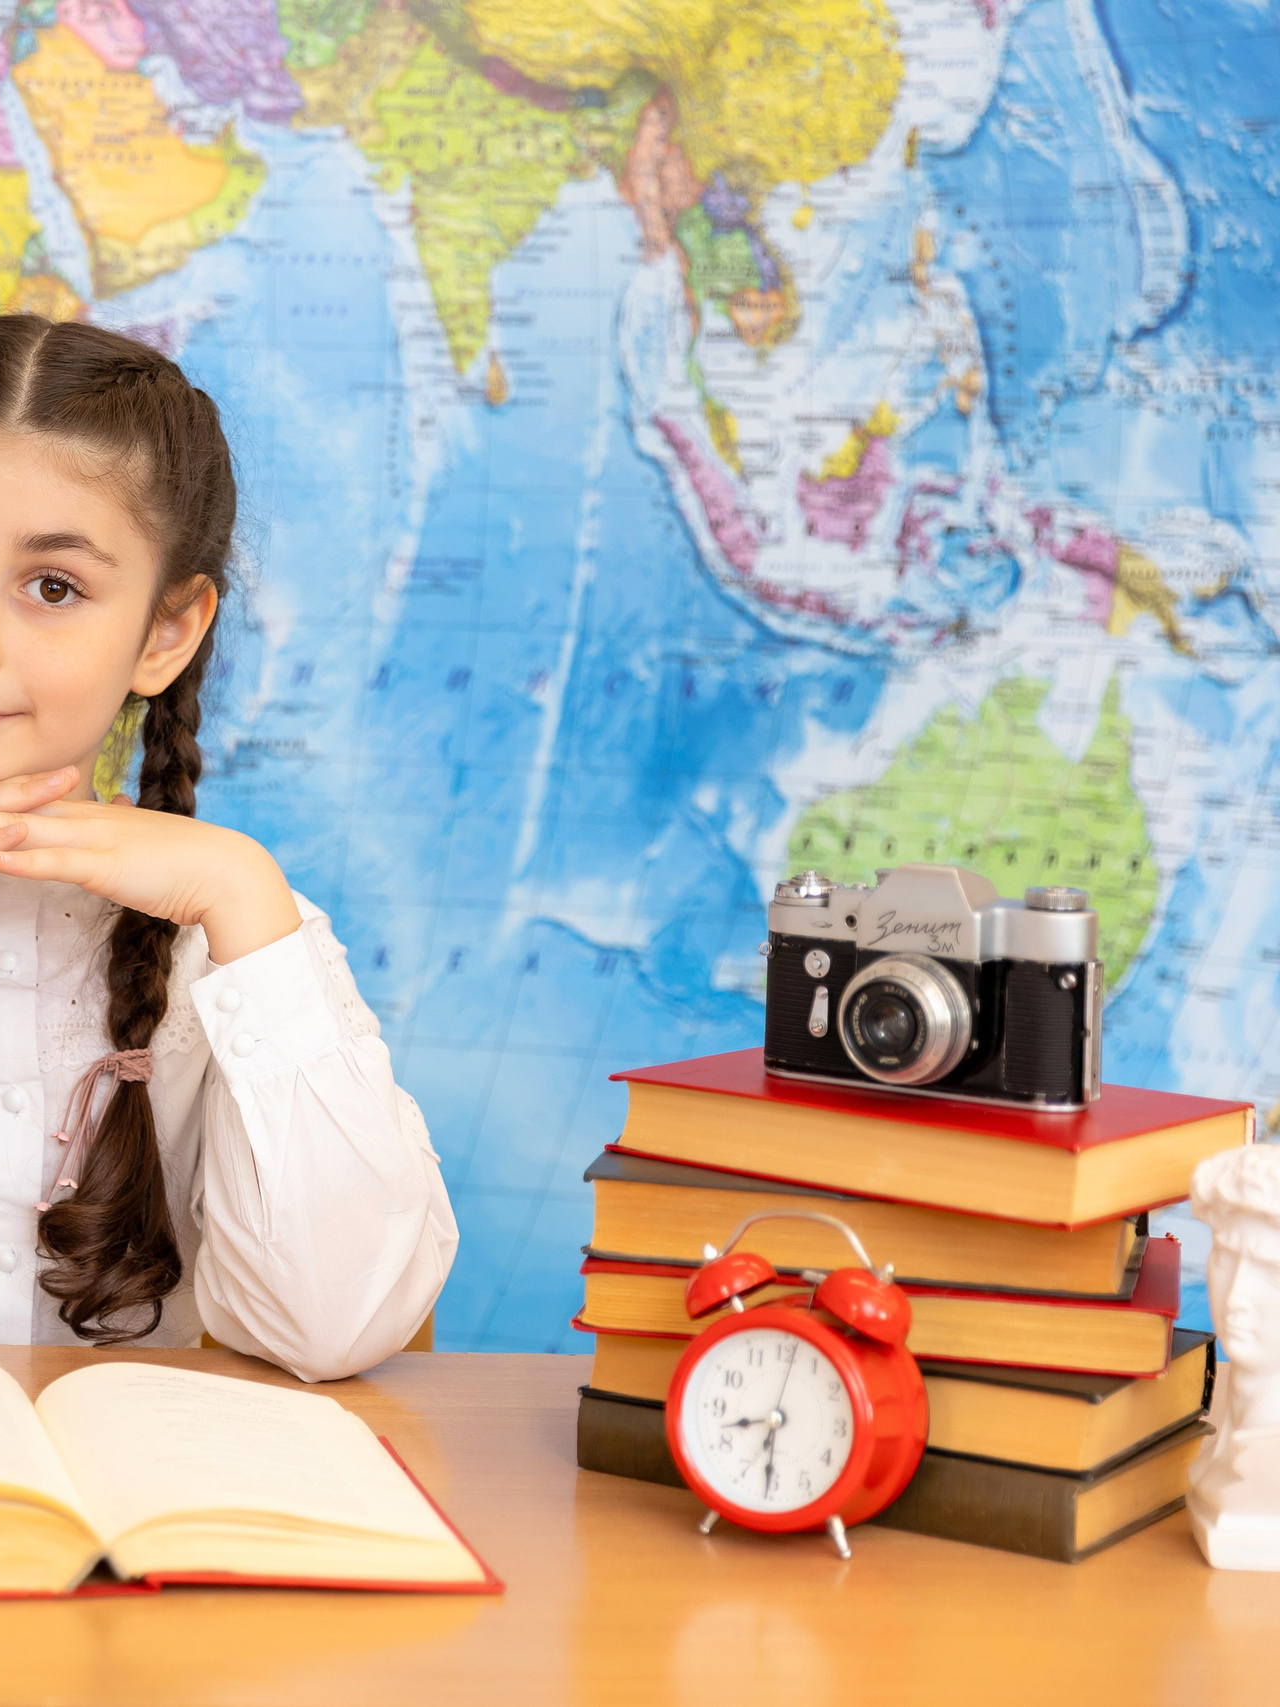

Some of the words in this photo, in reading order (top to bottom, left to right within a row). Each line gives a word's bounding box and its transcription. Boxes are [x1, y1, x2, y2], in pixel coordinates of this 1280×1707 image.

[746, 1348, 764, 1368] 11
[776, 1343, 798, 1365] 12
[811, 1357, 818, 1375] 1
[724, 1369, 744, 1390] 10
[827, 1380, 842, 1402] 2
[712, 1397, 727, 1418] 9
[833, 1417, 848, 1438] 3
[718, 1432, 733, 1453] 8
[820, 1447, 833, 1467] 4
[739, 1458, 752, 1479] 7
[798, 1469, 812, 1491] 5
